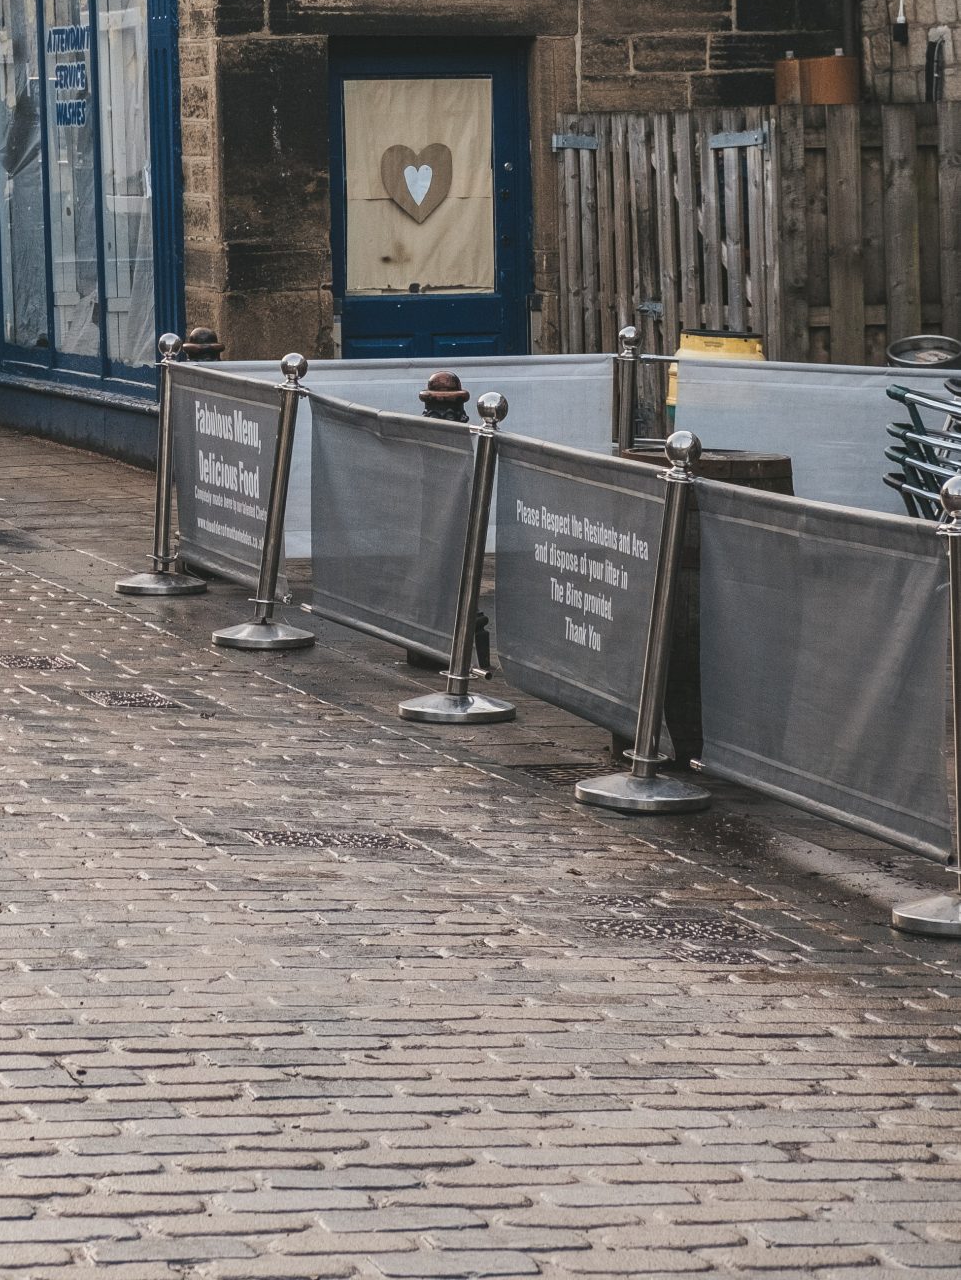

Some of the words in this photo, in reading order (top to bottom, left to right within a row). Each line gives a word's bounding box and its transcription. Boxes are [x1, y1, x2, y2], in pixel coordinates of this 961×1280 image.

[46, 25, 90, 54] ATTENDANT
[55, 62, 86, 91] SERVICE
[56, 100, 87, 127] WASHES
[195, 401, 234, 442] Fabulous
[233, 410, 262, 455] Menu,
[198, 450, 239, 492] Delicious
[238, 461, 260, 499] Food
[516, 499, 540, 527] Please
[541, 505, 570, 537] Respect
[572, 514, 583, 540] the
[584, 517, 618, 551] Residents
[618, 531, 631, 555] and
[632, 532, 649, 561] Area
[534, 541, 548, 564] and
[549, 543, 578, 573] dispose
[580, 552, 587, 575] of
[588, 558, 604, 583] your
[604, 559, 620, 587] litter
[620, 565, 628, 590] in
[550, 577, 564, 603] The
[565, 582, 583, 608] Bins
[583, 592, 614, 621] provided.
[565, 616, 587, 646] Thank
[588, 624, 601, 652] You
